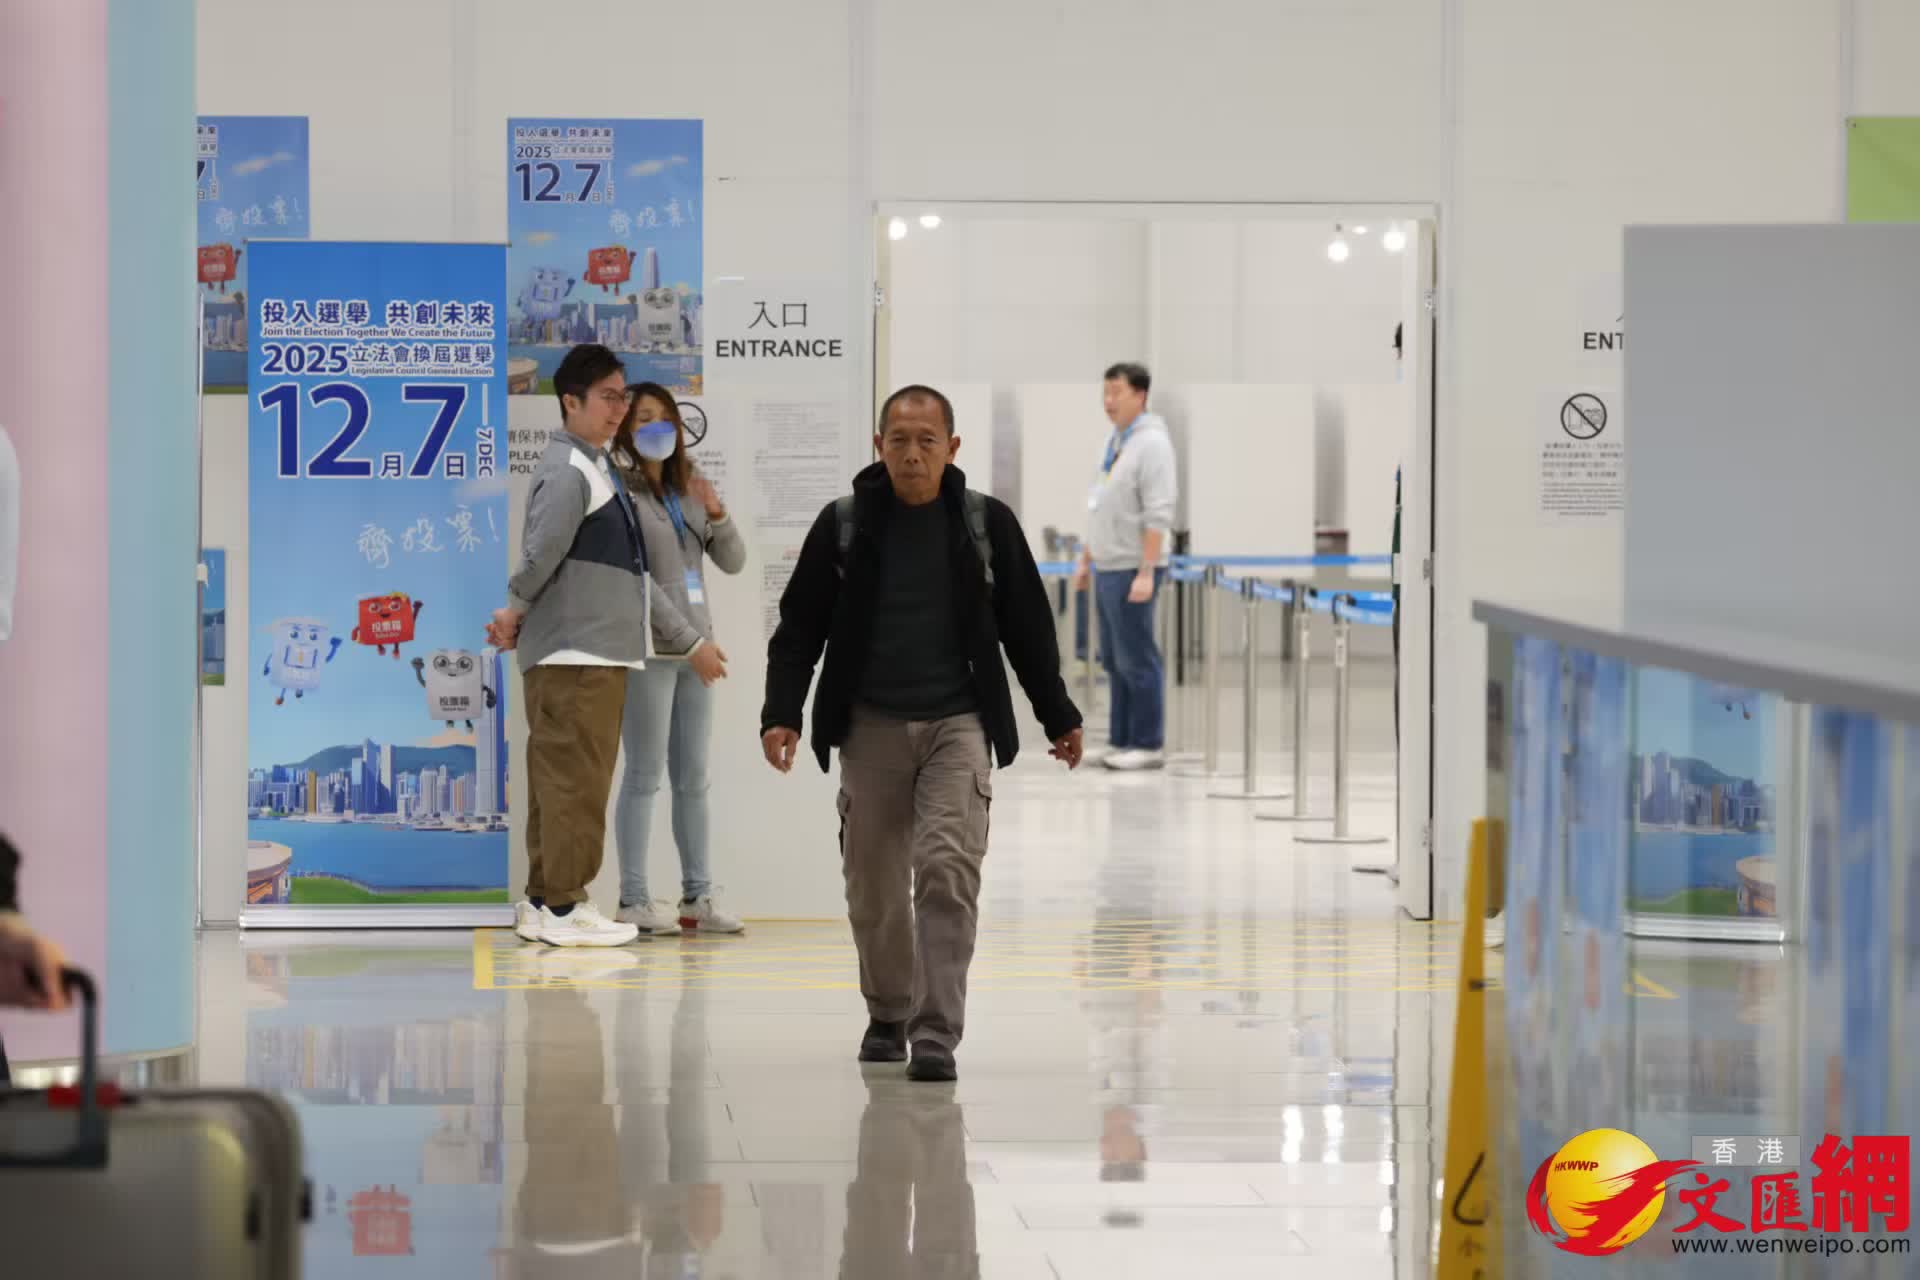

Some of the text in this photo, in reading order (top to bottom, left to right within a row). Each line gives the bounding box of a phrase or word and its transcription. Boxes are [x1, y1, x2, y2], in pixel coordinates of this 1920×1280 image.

[516, 146, 552, 159] 2025
[263, 301, 493, 325] 投入選舉 共創未來
[748, 301, 807, 329] 入口
[263, 328, 493, 339] Join the Election Together We Create the Future
[263, 344, 492, 373] 2025 立法會換屆選舉
[716, 339, 843, 358] ENTRANCE
[352, 367, 492, 376] Legislative Council General Election
[259, 383, 466, 478] 12月7日
[478, 443, 493, 477] DEC
[509, 451, 544, 460] PLEA
